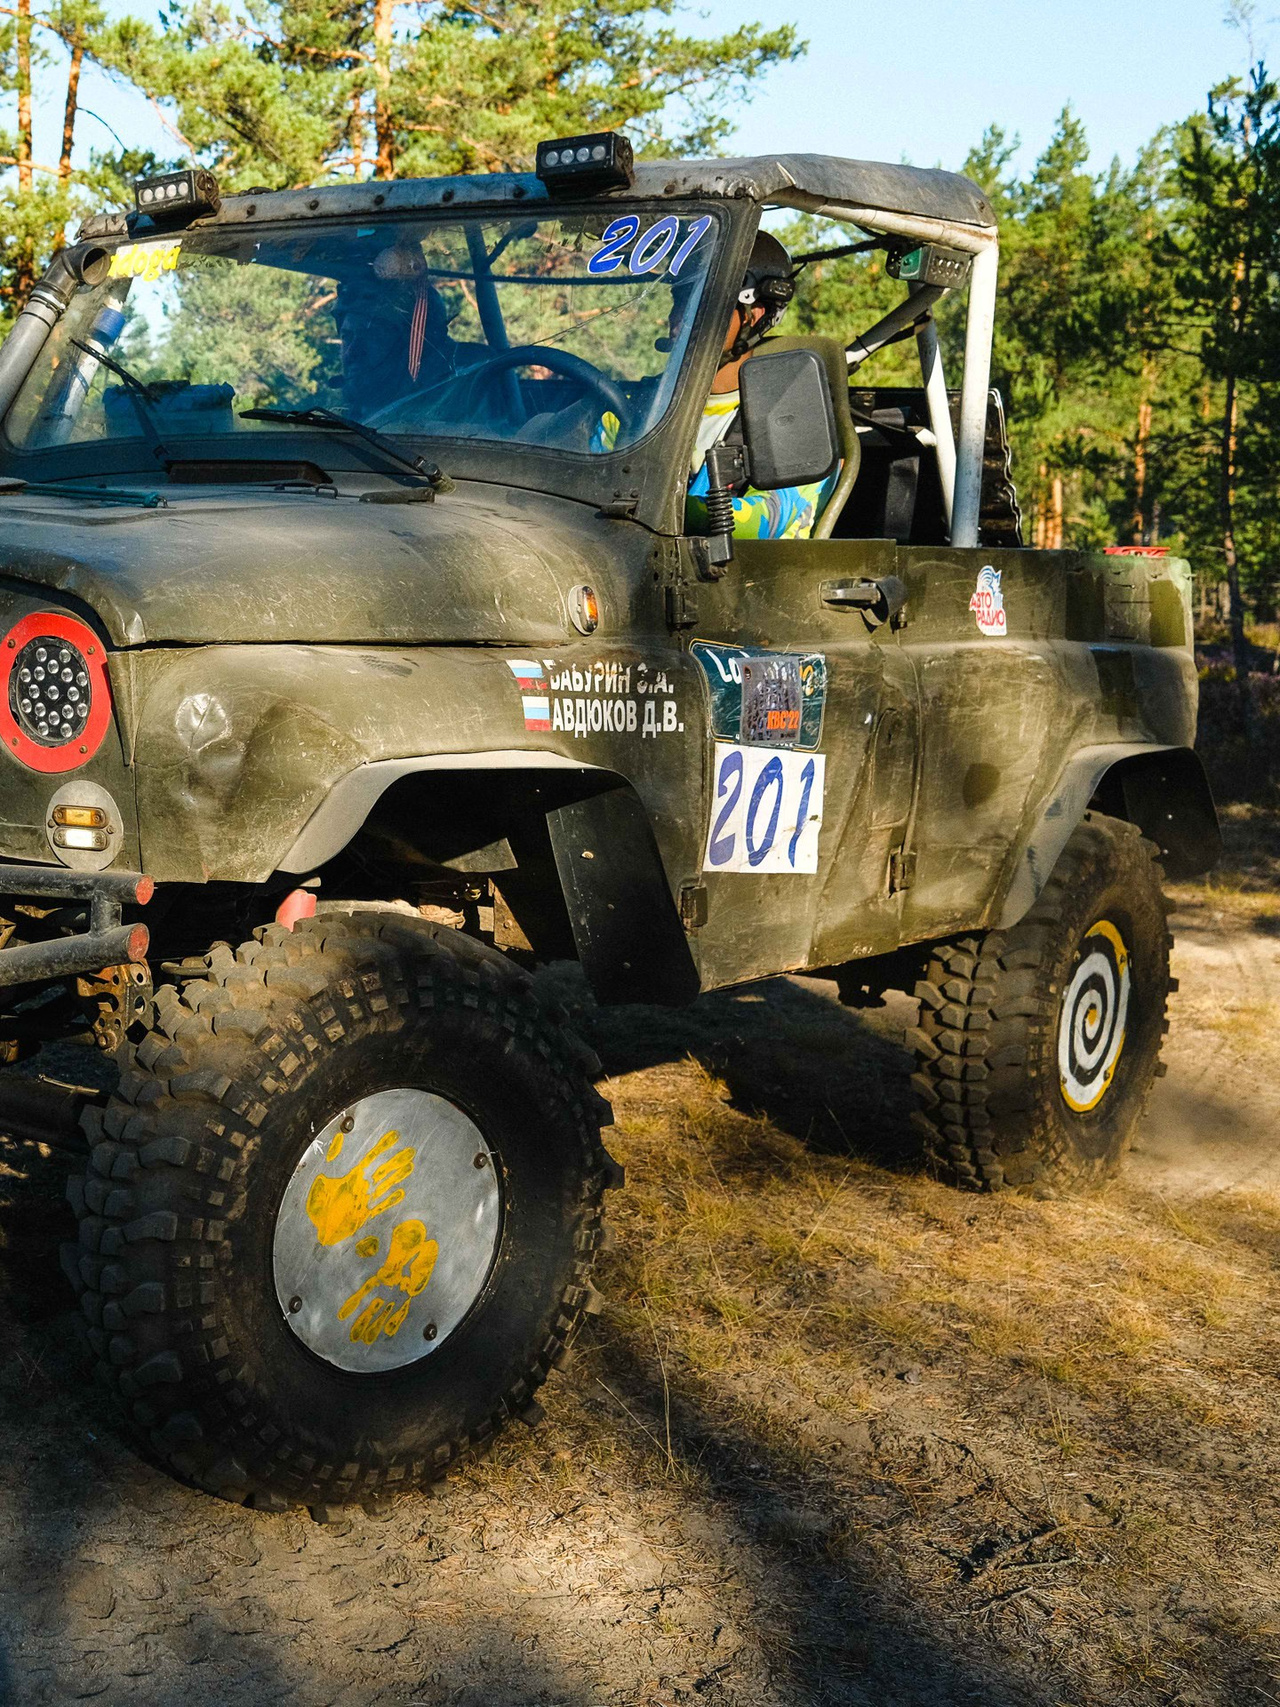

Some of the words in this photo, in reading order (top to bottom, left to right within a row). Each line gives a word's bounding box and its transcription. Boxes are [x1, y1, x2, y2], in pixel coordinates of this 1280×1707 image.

[587, 214, 712, 276] 201
[552, 698, 638, 738] АВДЮКОВ
[642, 700, 685, 738] Д.В.
[708, 750, 815, 868] 201
